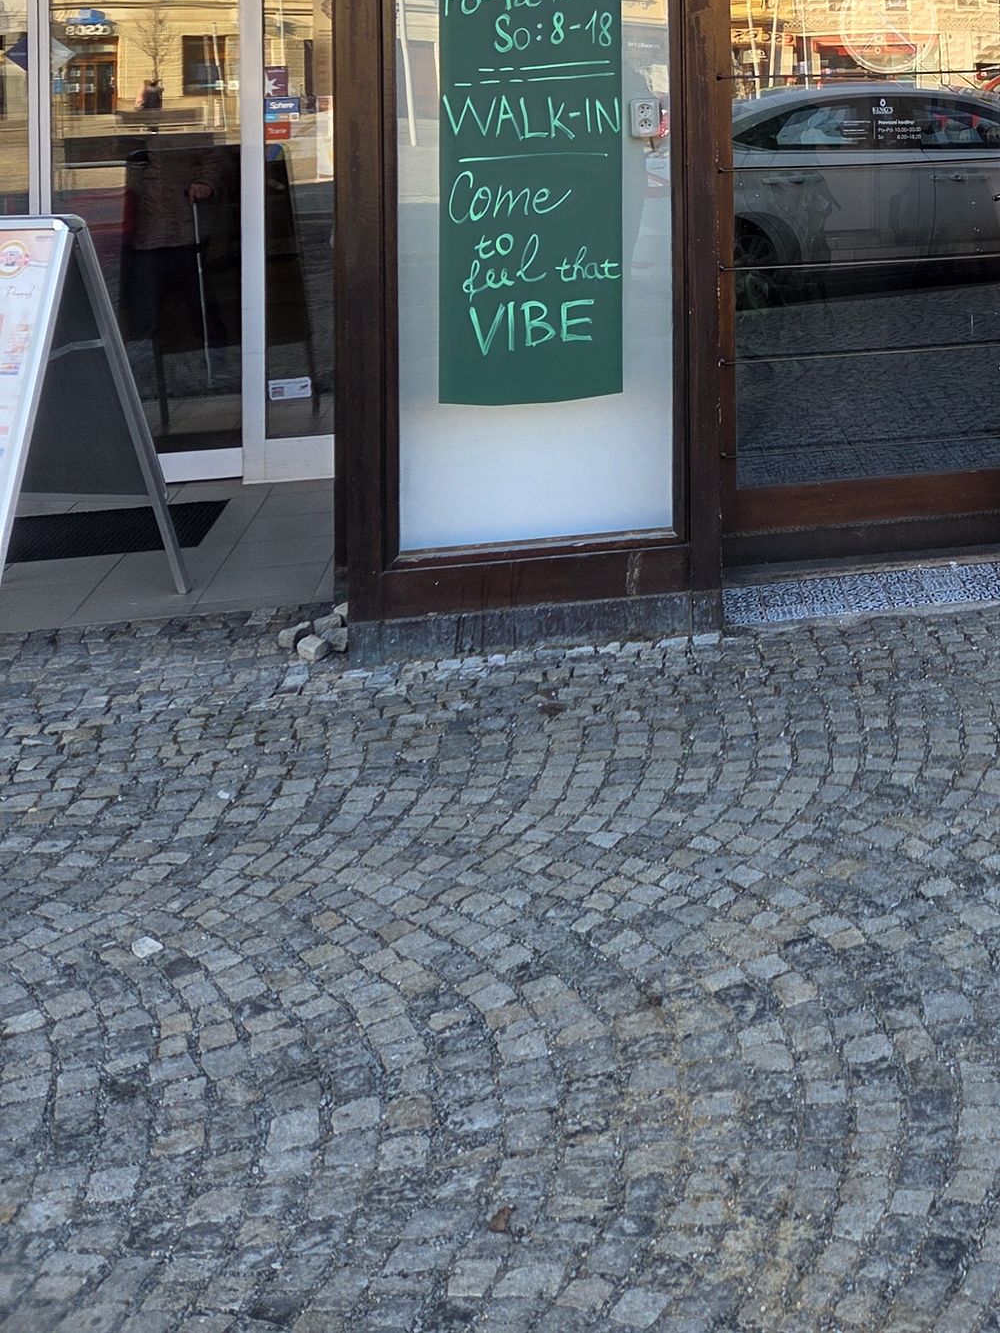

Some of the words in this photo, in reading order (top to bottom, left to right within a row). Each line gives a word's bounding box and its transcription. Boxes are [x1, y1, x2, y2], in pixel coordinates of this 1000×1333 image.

[442, 94, 621, 141] WALK-IN
[448, 170, 572, 224] Come
[474, 233, 514, 260] to
[555, 255, 622, 283] that
[469, 298, 595, 357] VIBE
